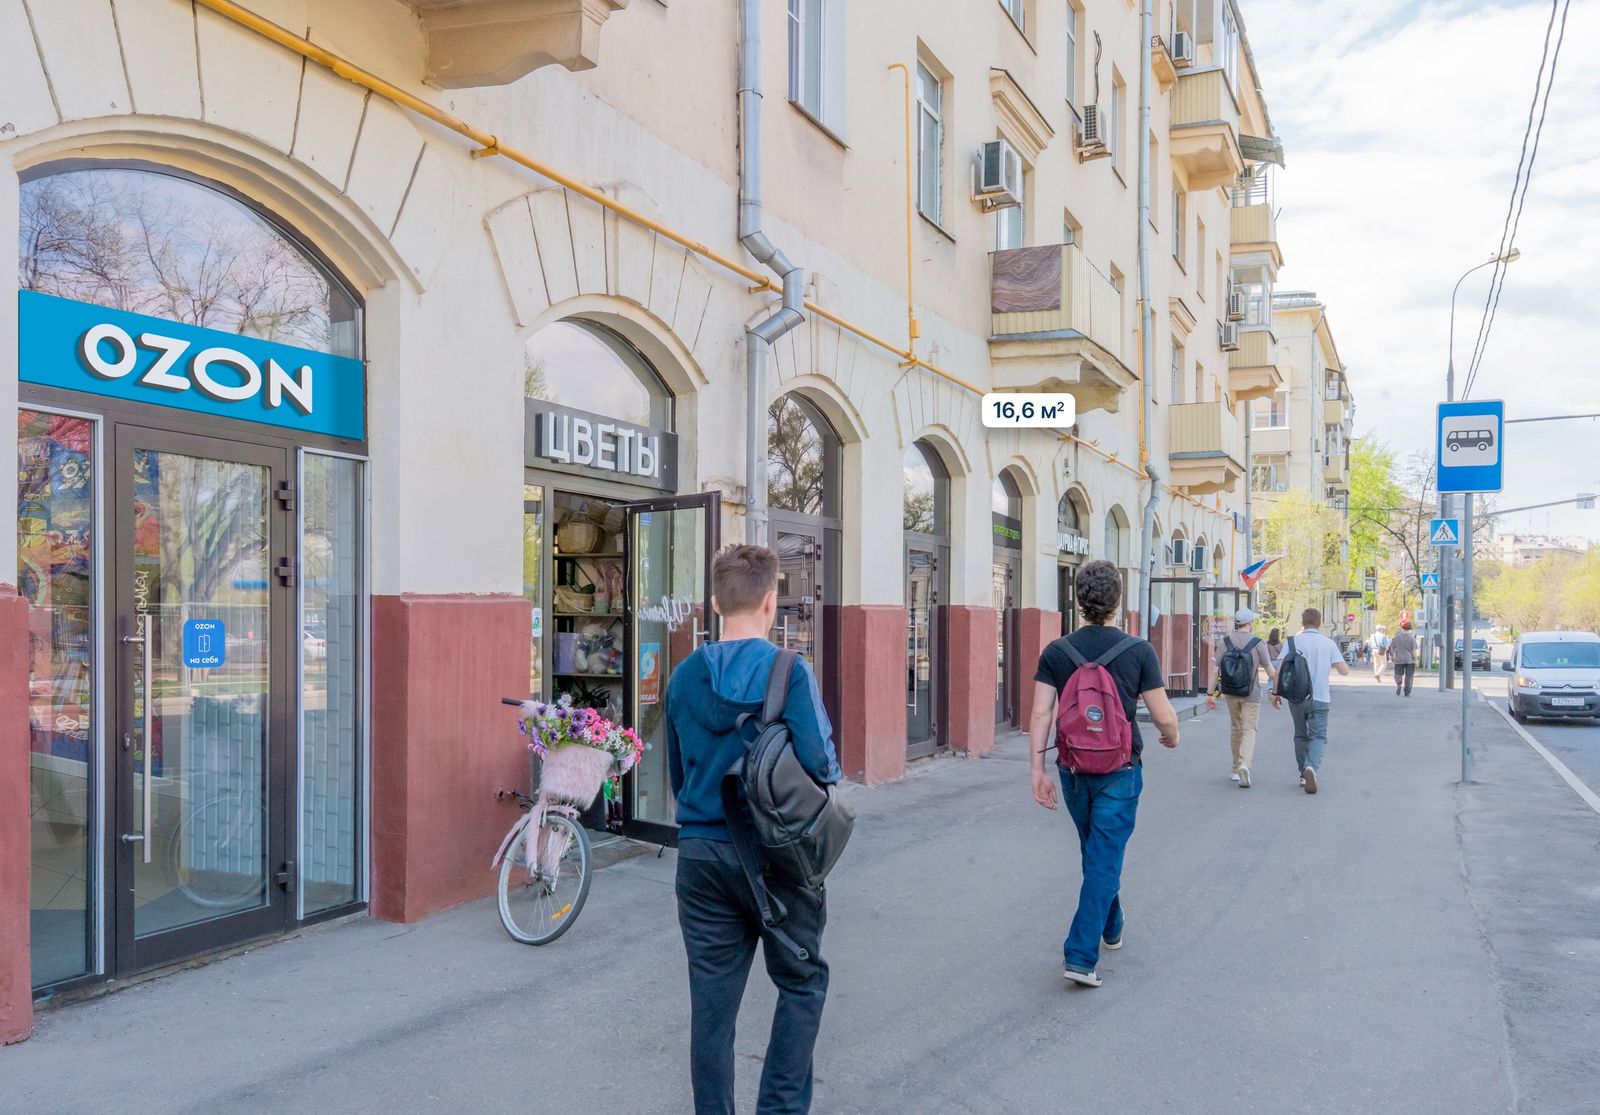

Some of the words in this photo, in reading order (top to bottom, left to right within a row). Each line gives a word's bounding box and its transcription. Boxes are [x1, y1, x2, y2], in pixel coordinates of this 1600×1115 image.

[82, 323, 313, 414] OZON
[544, 411, 659, 478] ЦВЕТЫ
[201, 655, 219, 664] себя
